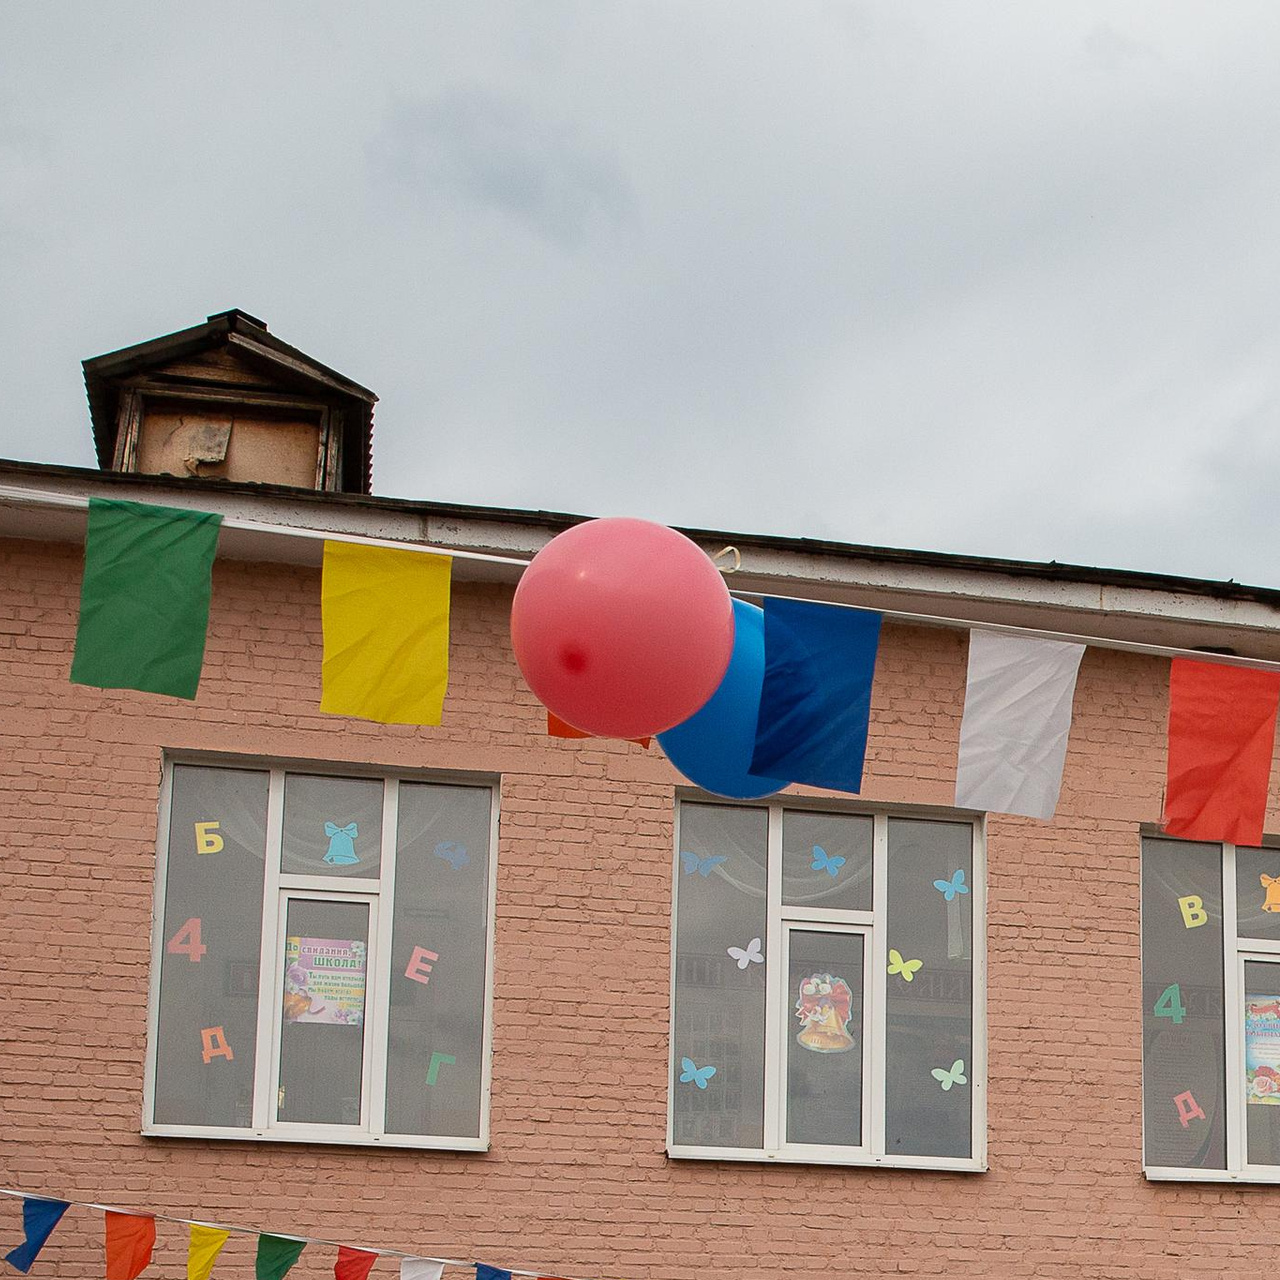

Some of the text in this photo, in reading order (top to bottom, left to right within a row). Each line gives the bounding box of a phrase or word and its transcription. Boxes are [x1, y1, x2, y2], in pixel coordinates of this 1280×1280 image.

[194, 821, 225, 855] Б
[1178, 894, 1208, 929] В
[167, 917, 207, 963] 4
[313, 957, 362, 968] ШКОЛА!
[404, 945, 440, 985] Е
[1153, 983, 1186, 1024] 4
[200, 1025, 234, 1065] Д
[425, 1052, 456, 1086] Г
[1173, 1090, 1205, 1128] Д
